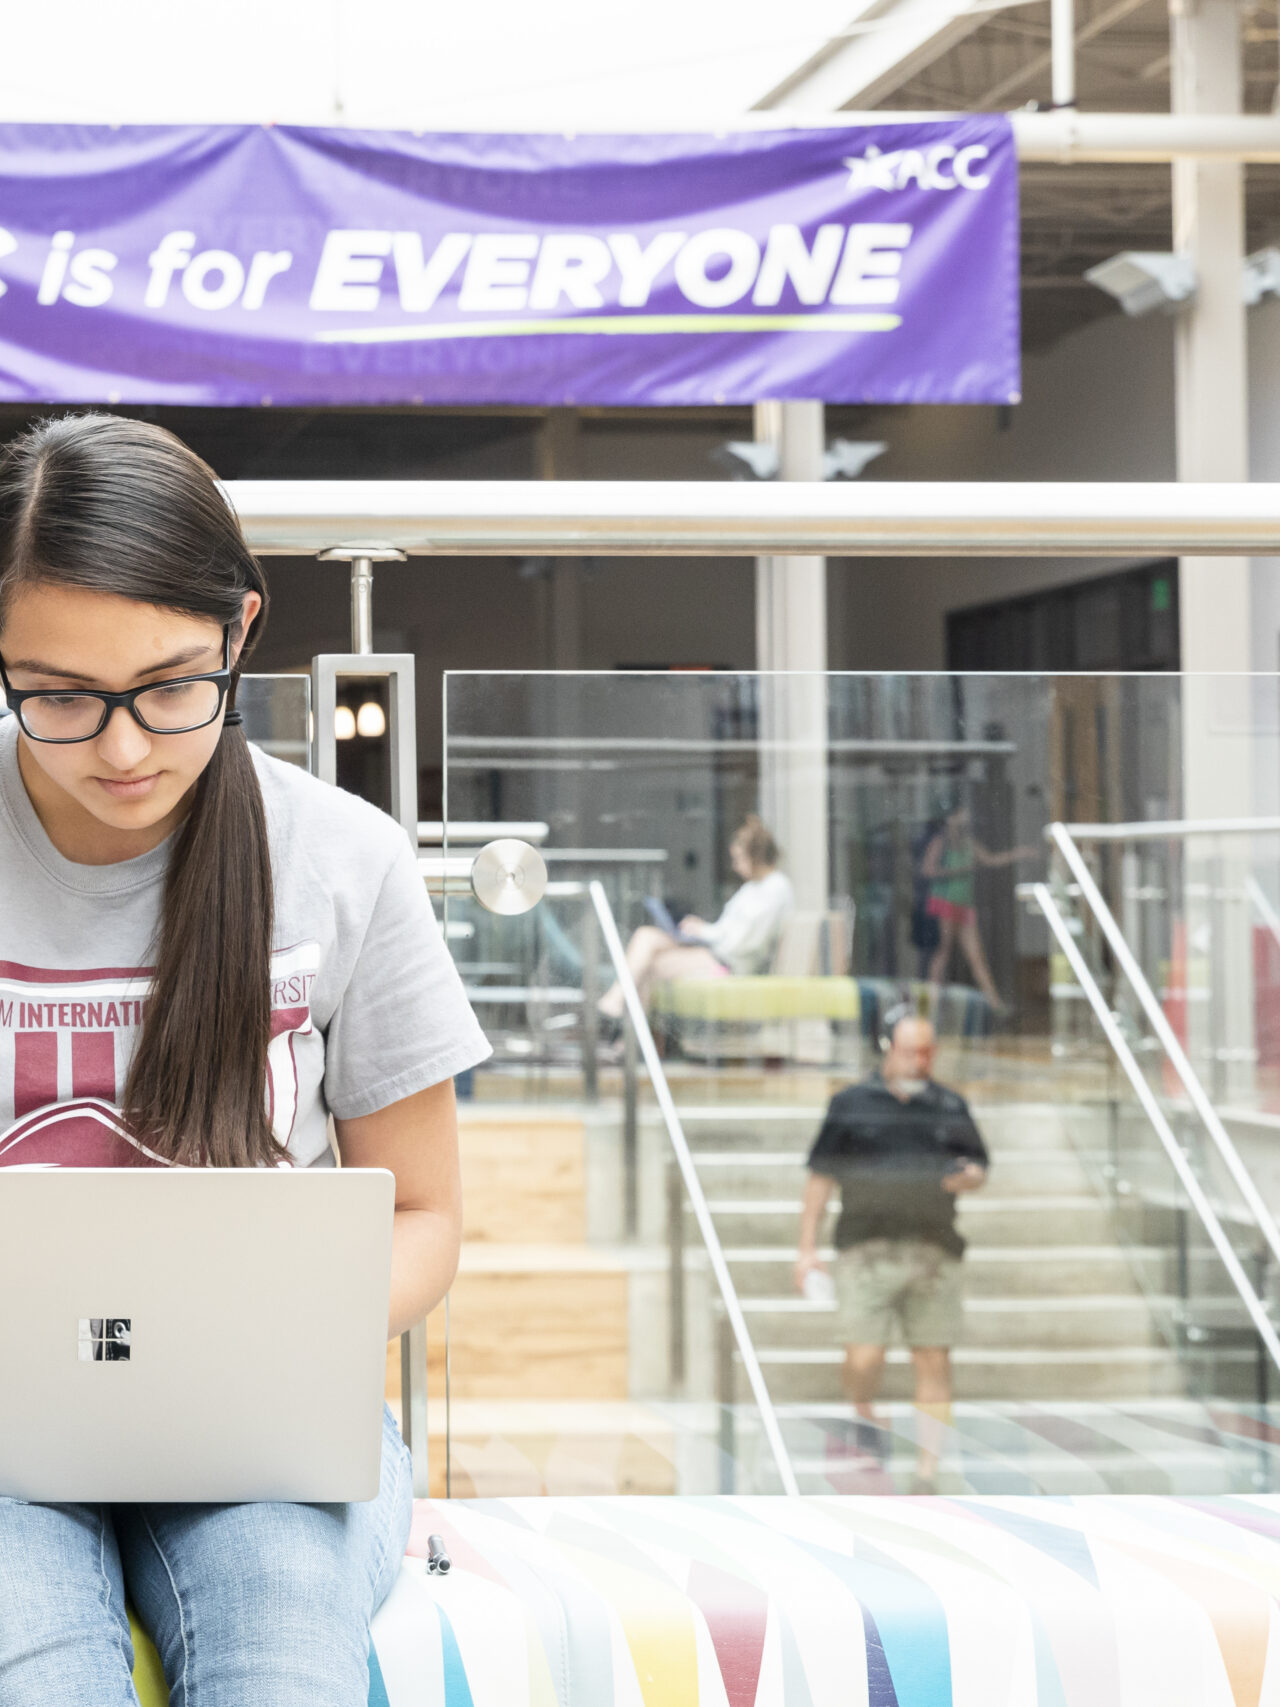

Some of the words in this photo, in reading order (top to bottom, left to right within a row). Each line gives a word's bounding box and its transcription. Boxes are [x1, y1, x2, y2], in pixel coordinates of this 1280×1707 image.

[896, 144, 990, 191] ACC
[36, 230, 119, 308] is
[143, 230, 294, 311] for
[309, 223, 913, 312] EVERYONE
[19, 1000, 147, 1029] INTERNATI
